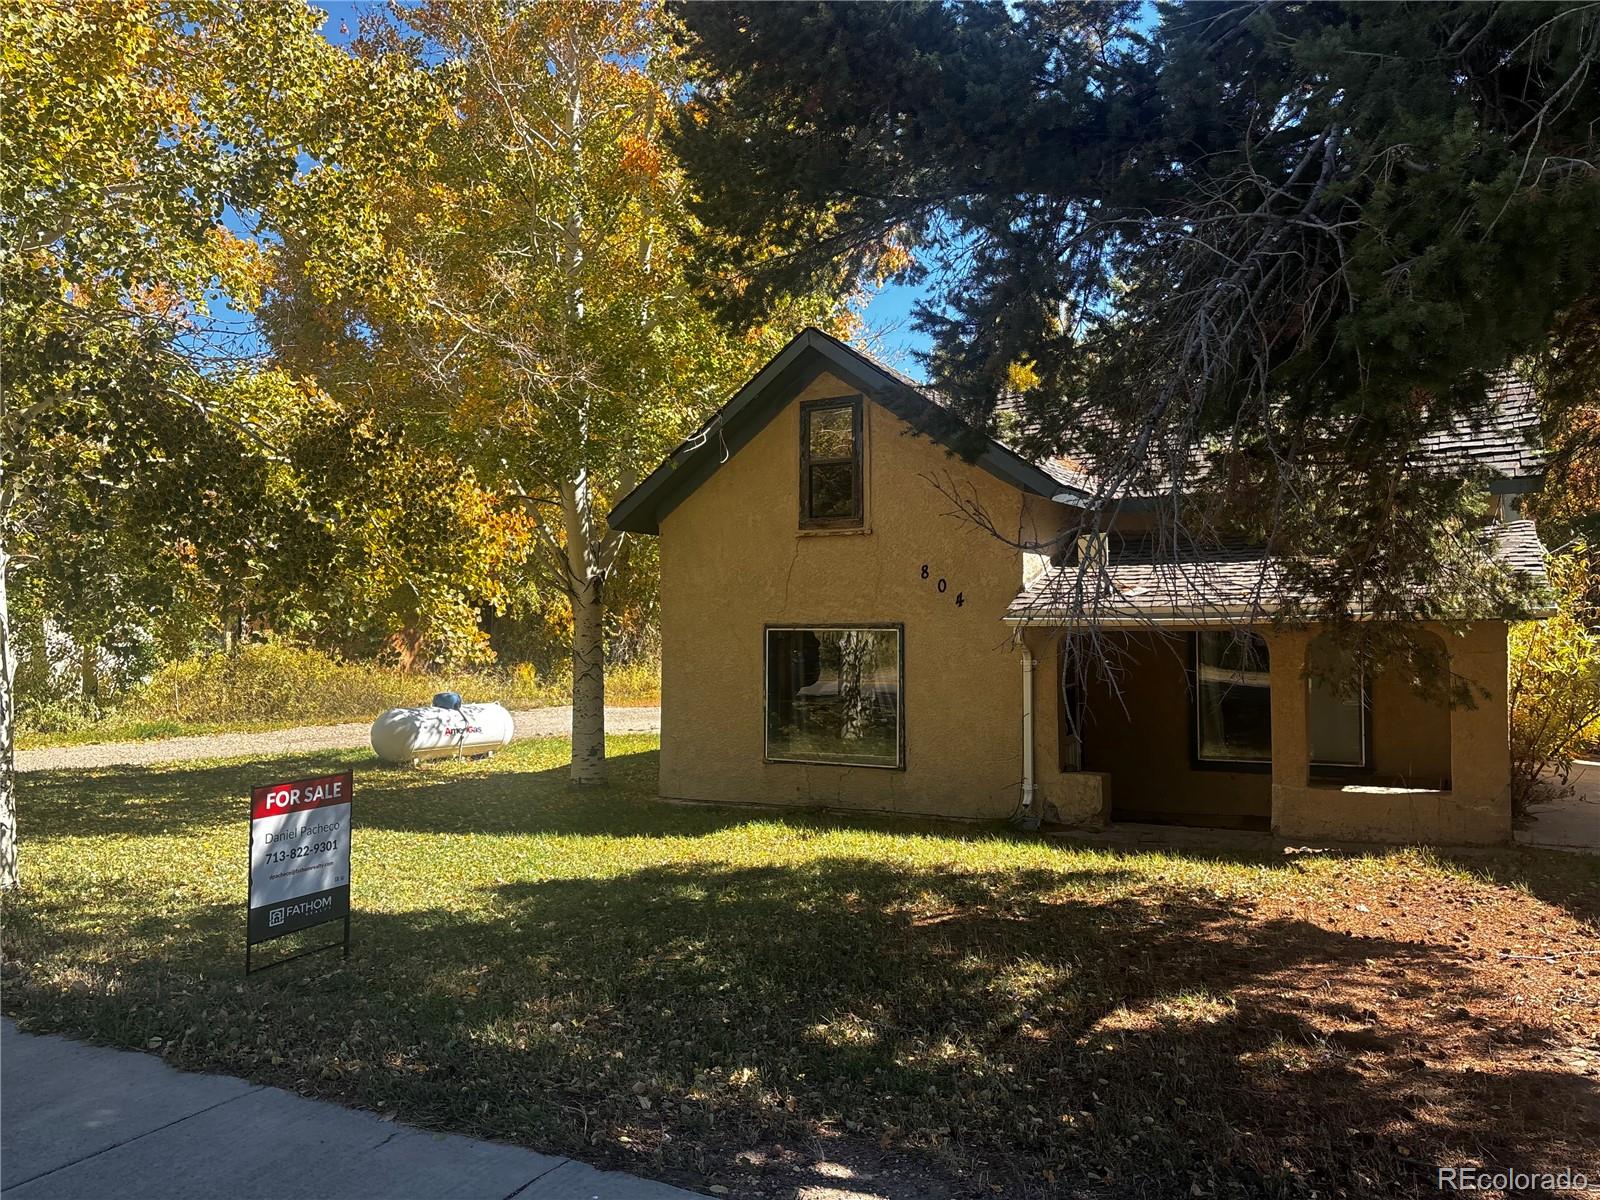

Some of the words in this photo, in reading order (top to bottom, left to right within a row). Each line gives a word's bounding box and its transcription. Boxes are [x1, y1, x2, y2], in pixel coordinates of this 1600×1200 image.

[920, 564, 965, 608] 804
[265, 789, 301, 810] FOR
[303, 782, 342, 803] SALE
[265, 828, 298, 844] Daniel
[300, 822, 340, 837] Pacheco
[265, 839, 338, 865] 713-822-9301
[286, 895, 332, 917] FATHOM
